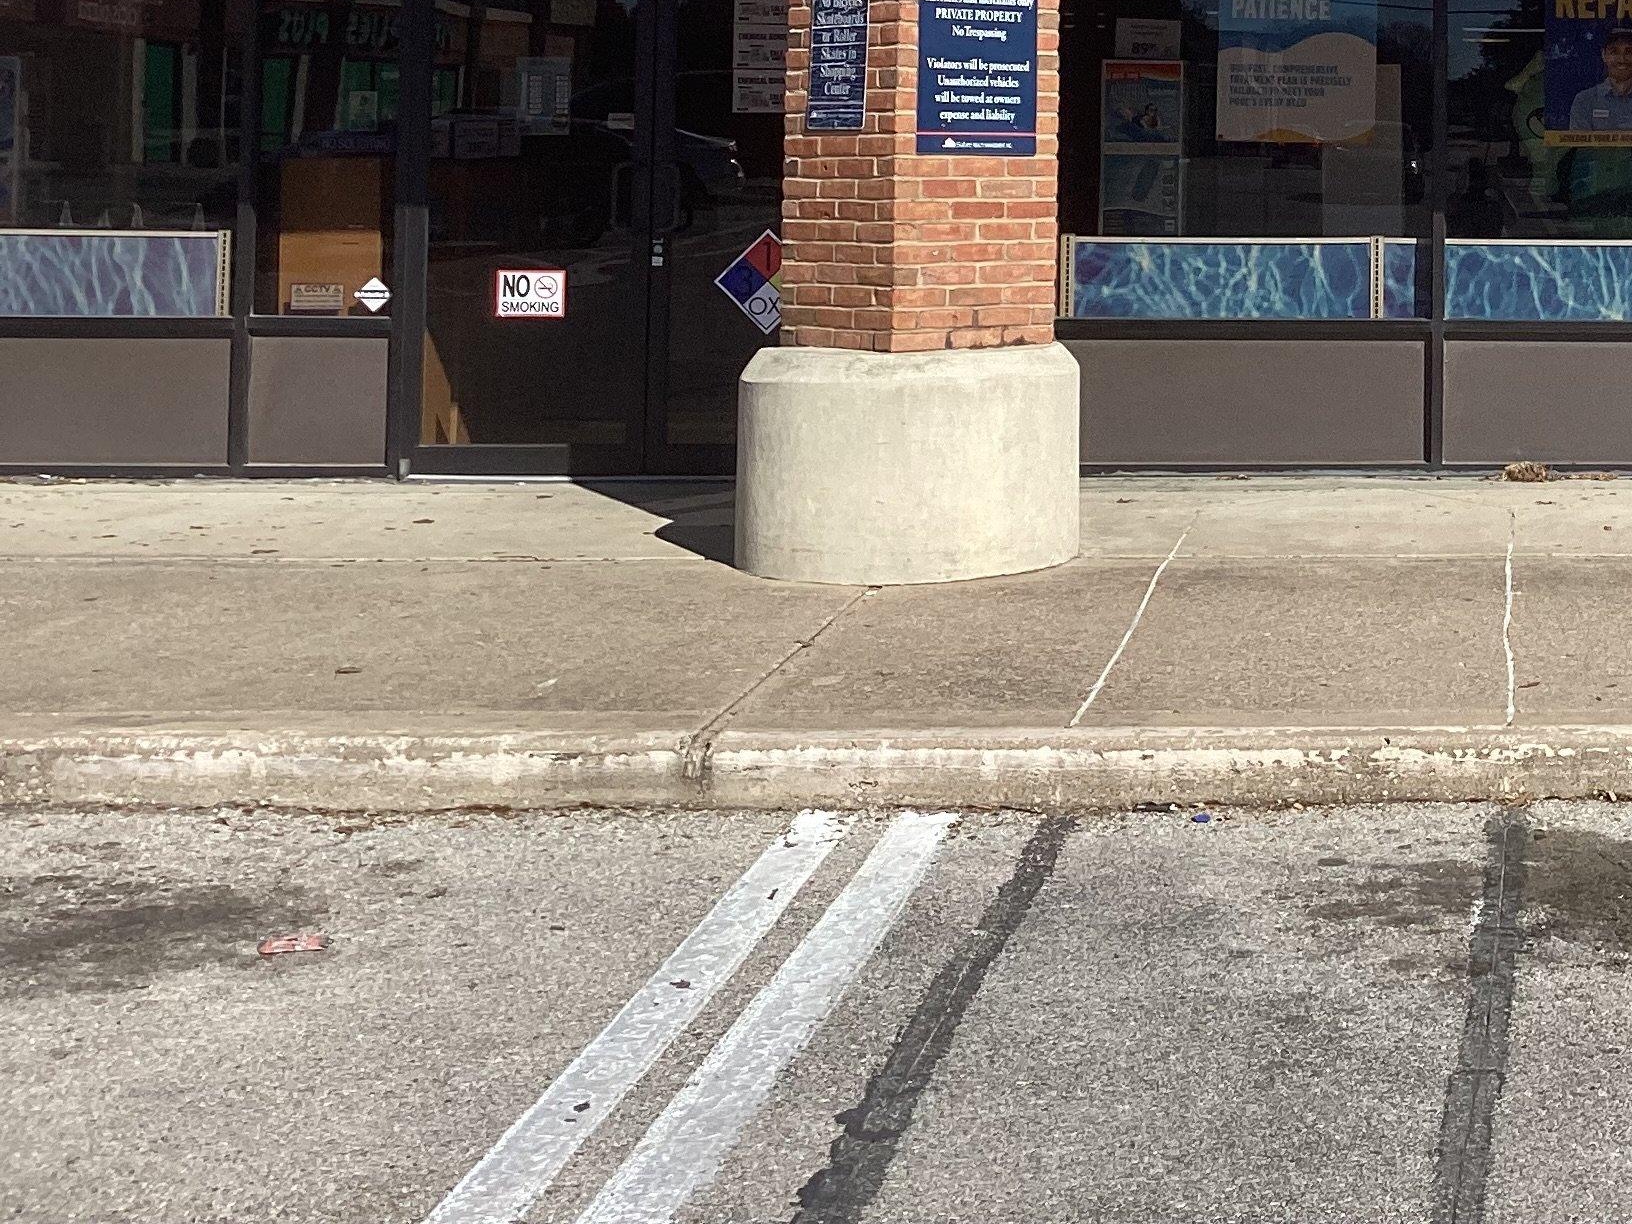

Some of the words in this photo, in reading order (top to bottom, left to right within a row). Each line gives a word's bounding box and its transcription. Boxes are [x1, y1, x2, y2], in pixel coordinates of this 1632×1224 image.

[816, 11, 864, 25] Skateboards
[935, 7, 974, 20] PRIVATE
[974, 9, 1023, 23] PROPERTY
[833, 28, 858, 42] Roller
[951, 25, 964, 36] No
[964, 25, 1007, 42] Trespassing
[820, 47, 847, 60] Skates
[819, 65, 856, 81] Shopping
[926, 57, 962, 70] Violators
[962, 58, 978, 70] will
[978, 58, 989, 70] be
[988, 60, 1030, 74] prosecuted
[824, 81, 851, 95] Center
[937, 74, 989, 87] Unauthorized
[989, 76, 1019, 88] vehicles
[934, 91, 949, 103] will
[950, 91, 960, 103] be
[960, 91, 984, 104] towed
[985, 94, 994, 104] at
[993, 96, 1021, 105] owners
[939, 111, 970, 123] expense
[970, 108, 985, 120] and
[985, 108, 1016, 124] liability
[762, 241, 772, 272] 1
[304, 285, 331, 293] CCTV
[502, 274, 530, 297] NO
[501, 301, 560, 313] SMOKING
[749, 297, 781, 316] OX
